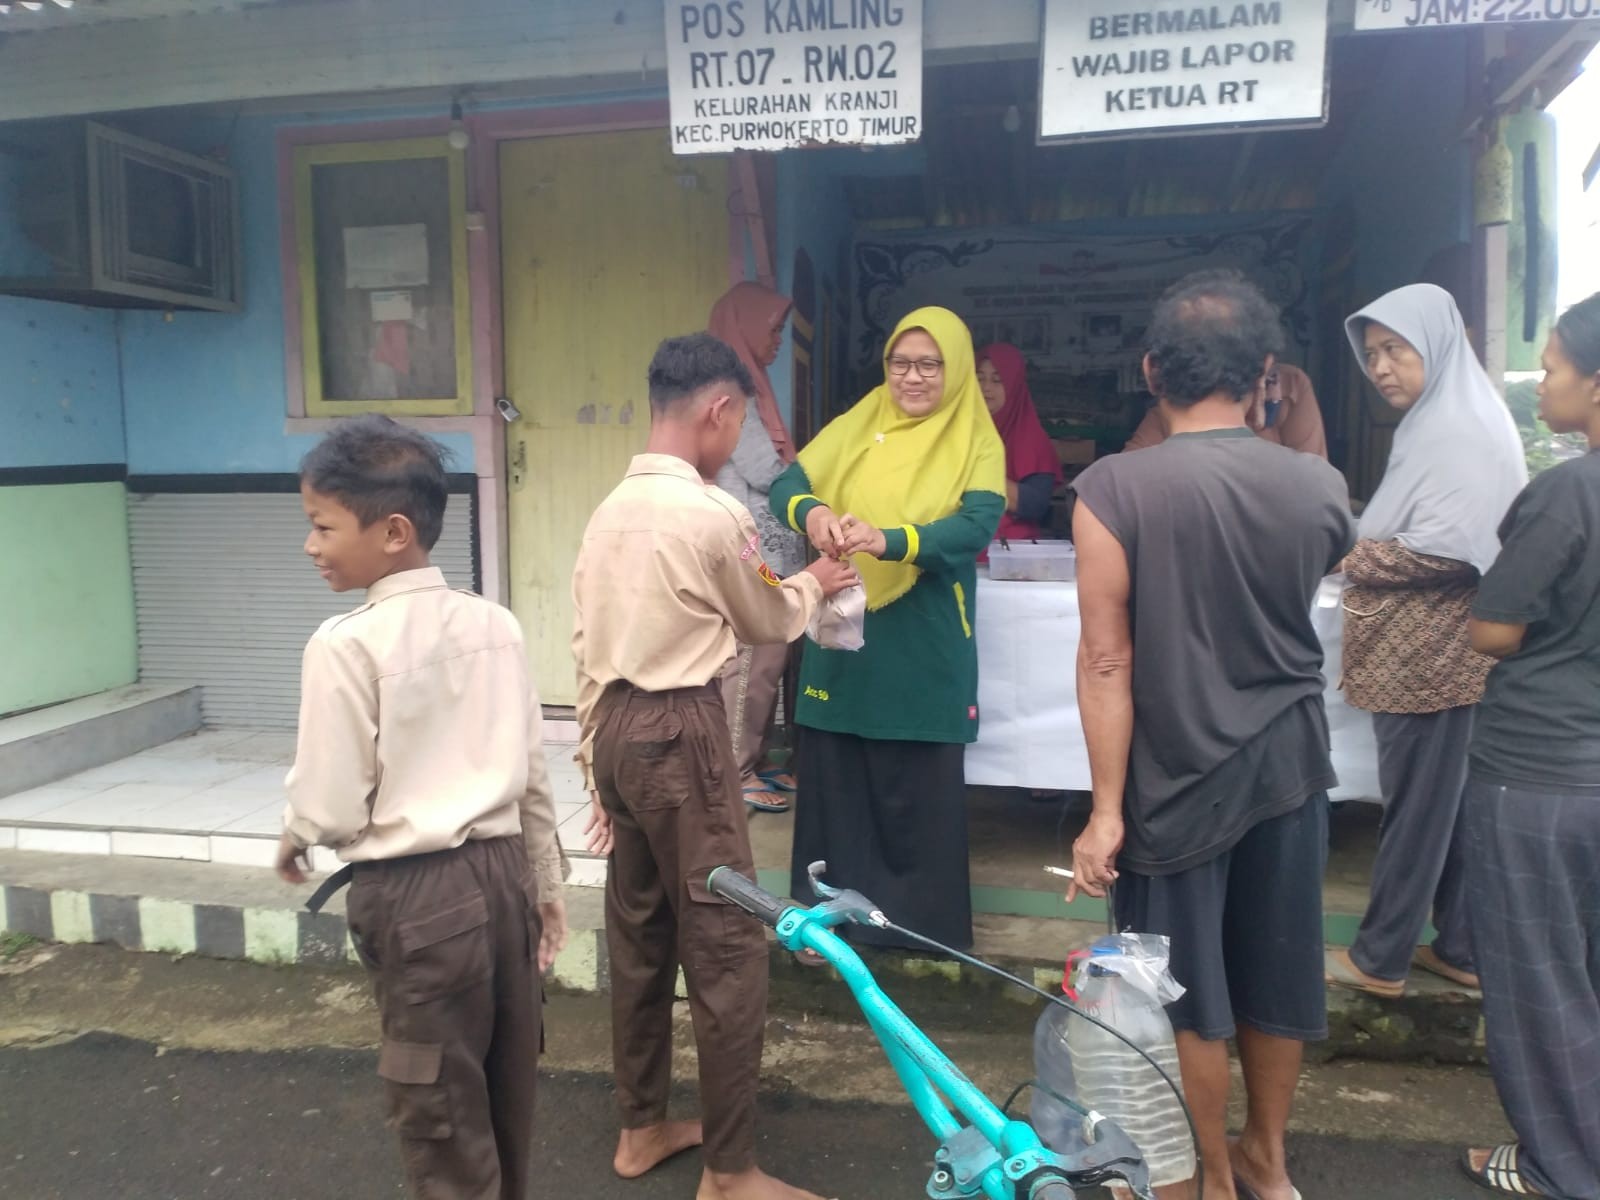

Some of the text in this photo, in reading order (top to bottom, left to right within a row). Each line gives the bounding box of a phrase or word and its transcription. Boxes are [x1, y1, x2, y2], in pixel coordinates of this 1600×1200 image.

[681, 0, 903, 43] POS KAMLING
[1089, 1, 1281, 40] BERMALAM
[690, 47, 775, 88] RT.07
[804, 41, 897, 83] RW.02
[1072, 39, 1294, 77] WAJIB LAPOR
[694, 90, 898, 118] KELURAHAN KRANJI
[1105, 79, 1259, 113] KETUA RT
[675, 116, 917, 144] KEC.PURWOKERTO TIMUR
